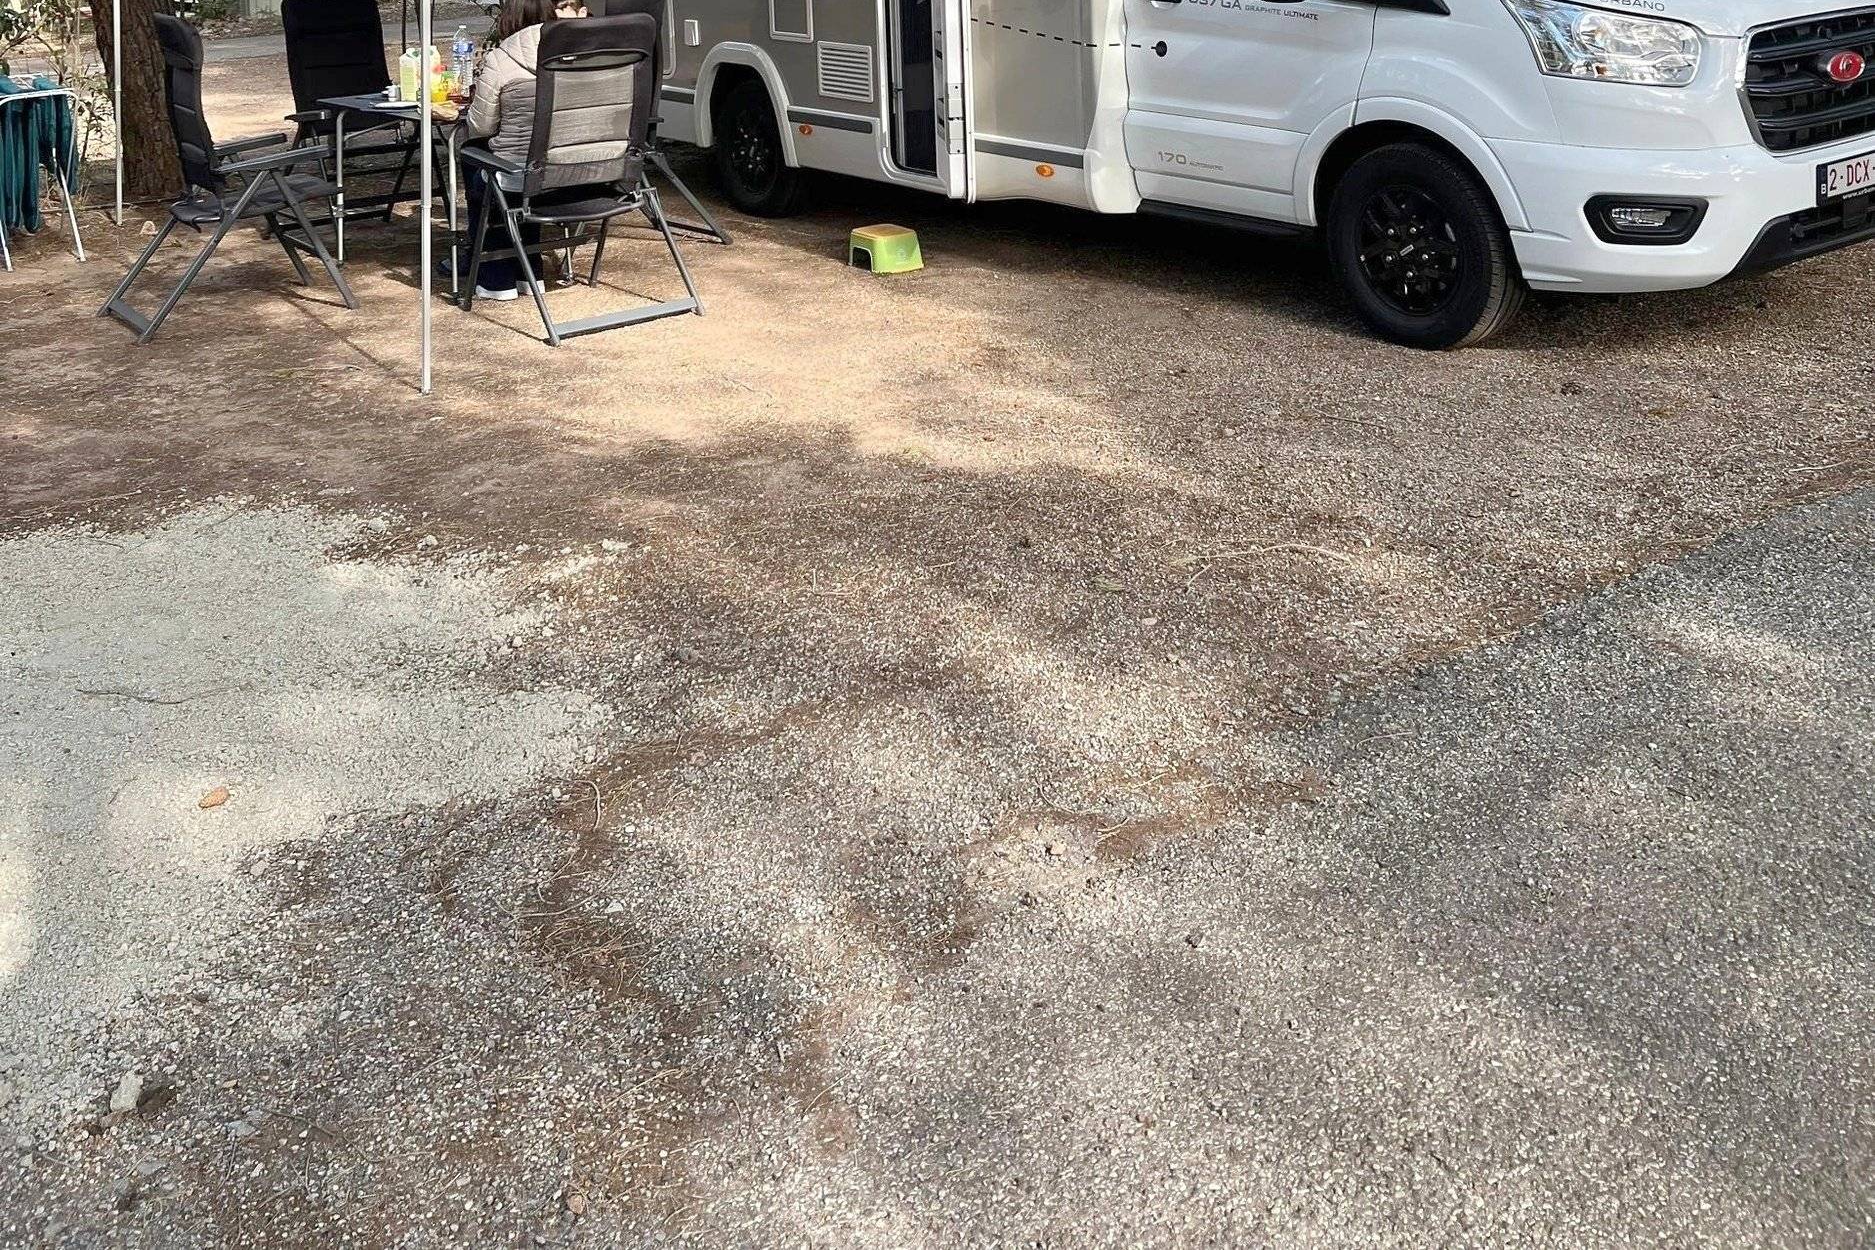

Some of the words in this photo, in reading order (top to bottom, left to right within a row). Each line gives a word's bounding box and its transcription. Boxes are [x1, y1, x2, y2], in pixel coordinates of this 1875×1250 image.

[1244, 5, 1281, 15] GRAPHITE
[1283, 9, 1319, 21] ULTIMATE
[1158, 151, 1187, 165] 170
[1820, 183, 1826, 194] B
